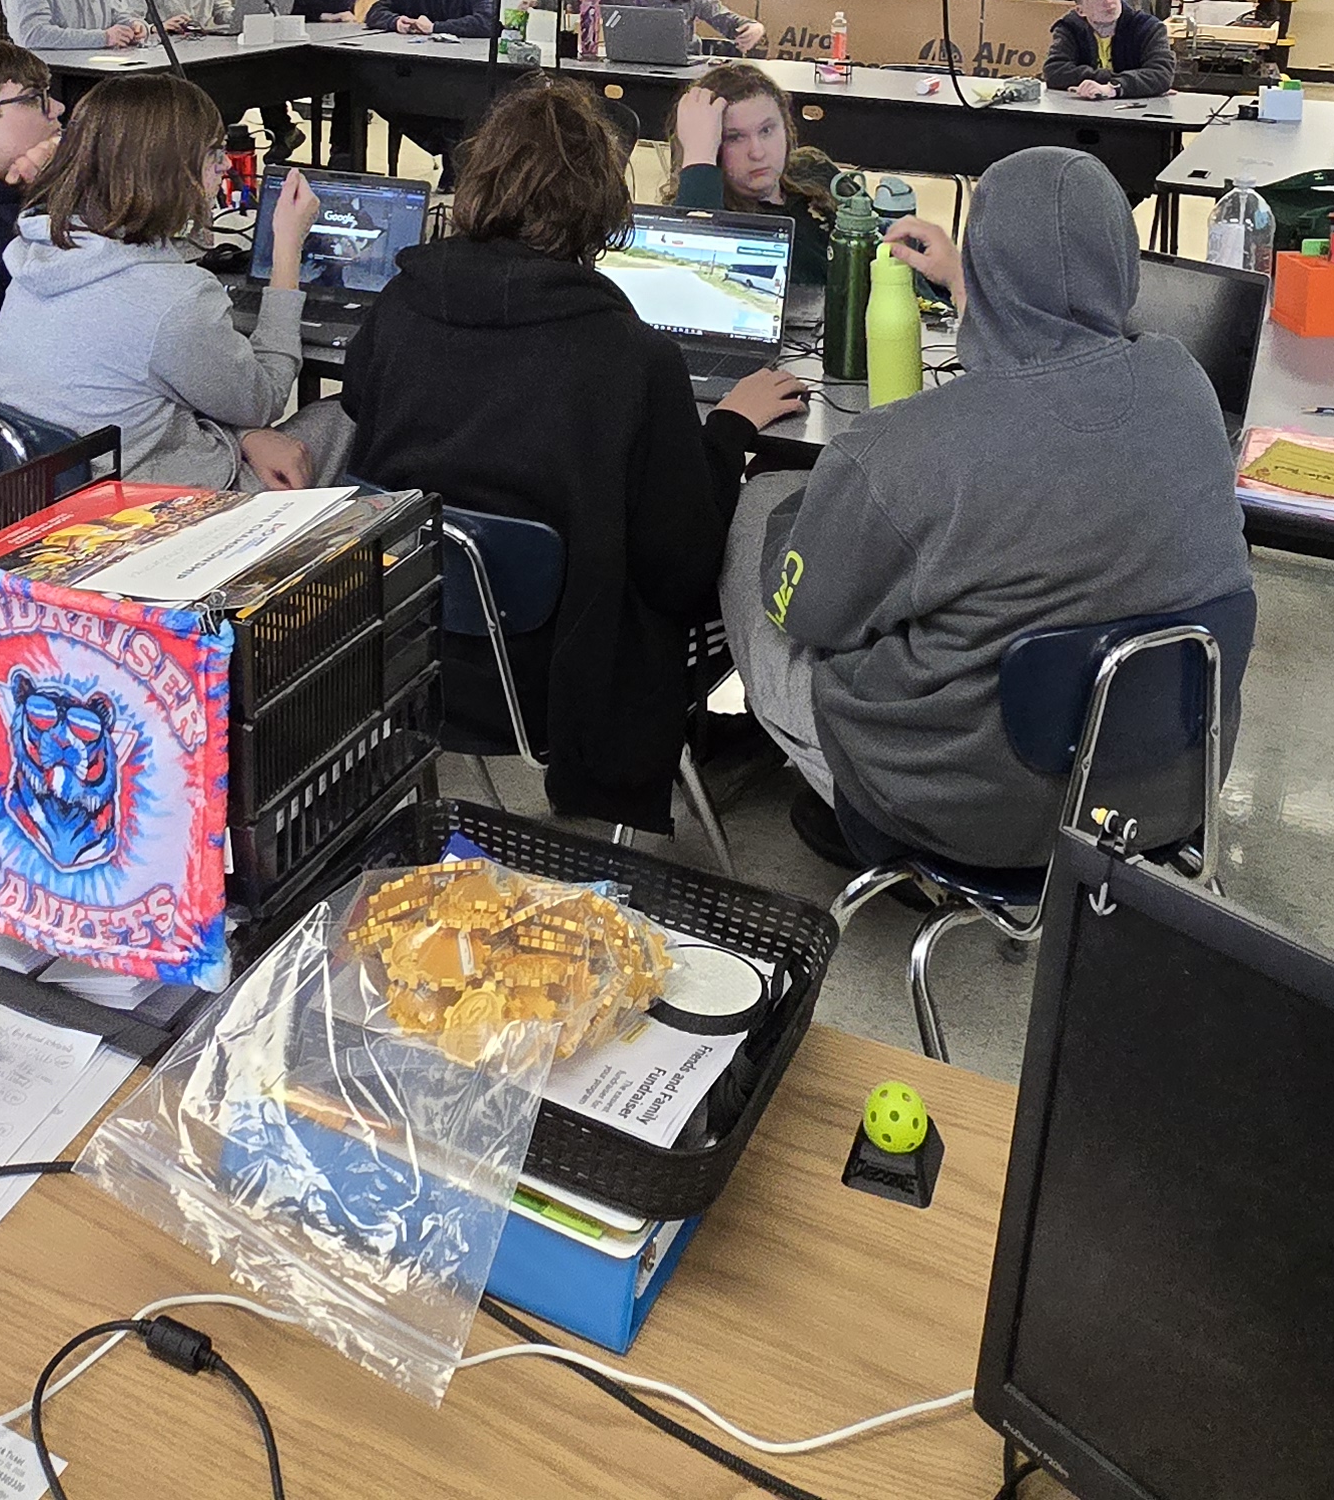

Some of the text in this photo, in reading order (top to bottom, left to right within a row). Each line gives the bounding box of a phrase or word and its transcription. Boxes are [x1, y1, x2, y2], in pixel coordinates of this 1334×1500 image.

[778, 25, 832, 50] Alro
[973, 41, 1036, 67] Alro
[176, 523, 264, 580] CHAMPIONSHIP
[617, 1066, 667, 1119] Fundraiser
[635, 1044, 713, 1126] Friends and Family
